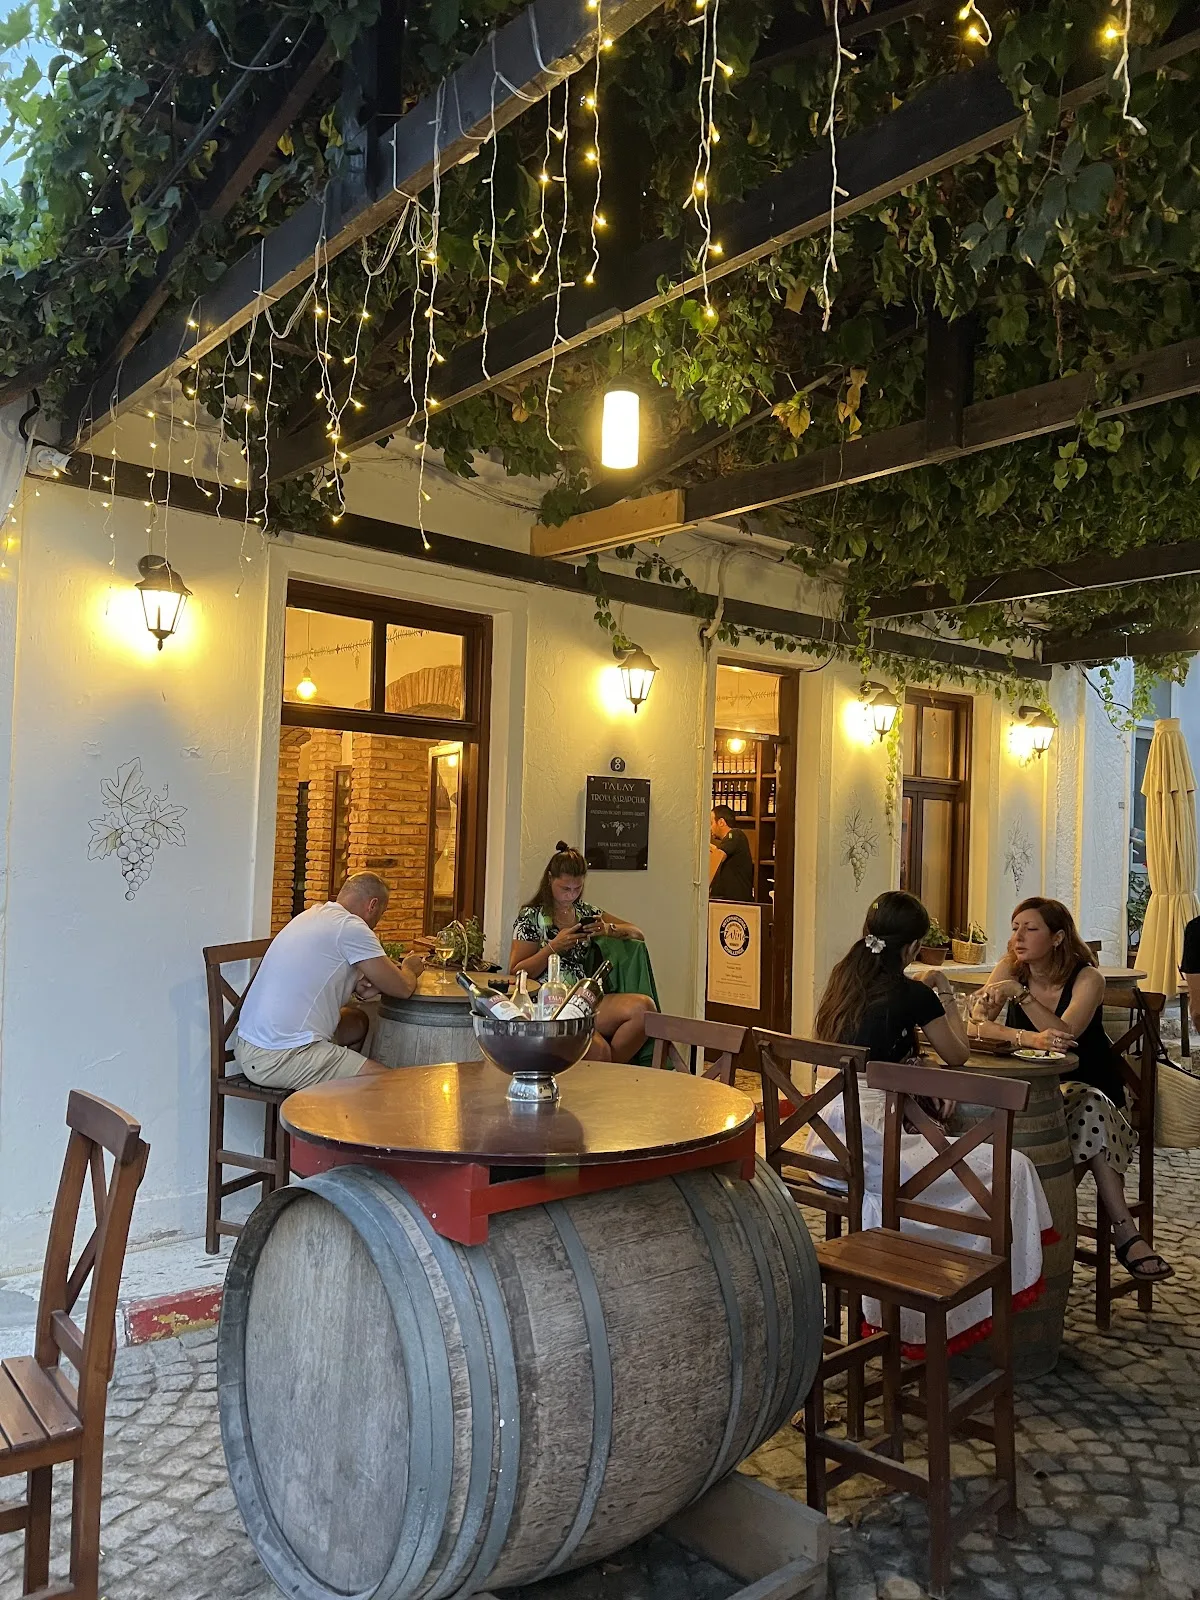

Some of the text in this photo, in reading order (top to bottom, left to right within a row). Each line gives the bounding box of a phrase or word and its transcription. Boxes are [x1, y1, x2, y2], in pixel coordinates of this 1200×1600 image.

[615, 758, 621, 770] 8
[602, 781, 635, 792] TALAY
[722, 916, 747, 930] INTERNATIONAL
[724, 946, 744, 956] CHALLENGE
